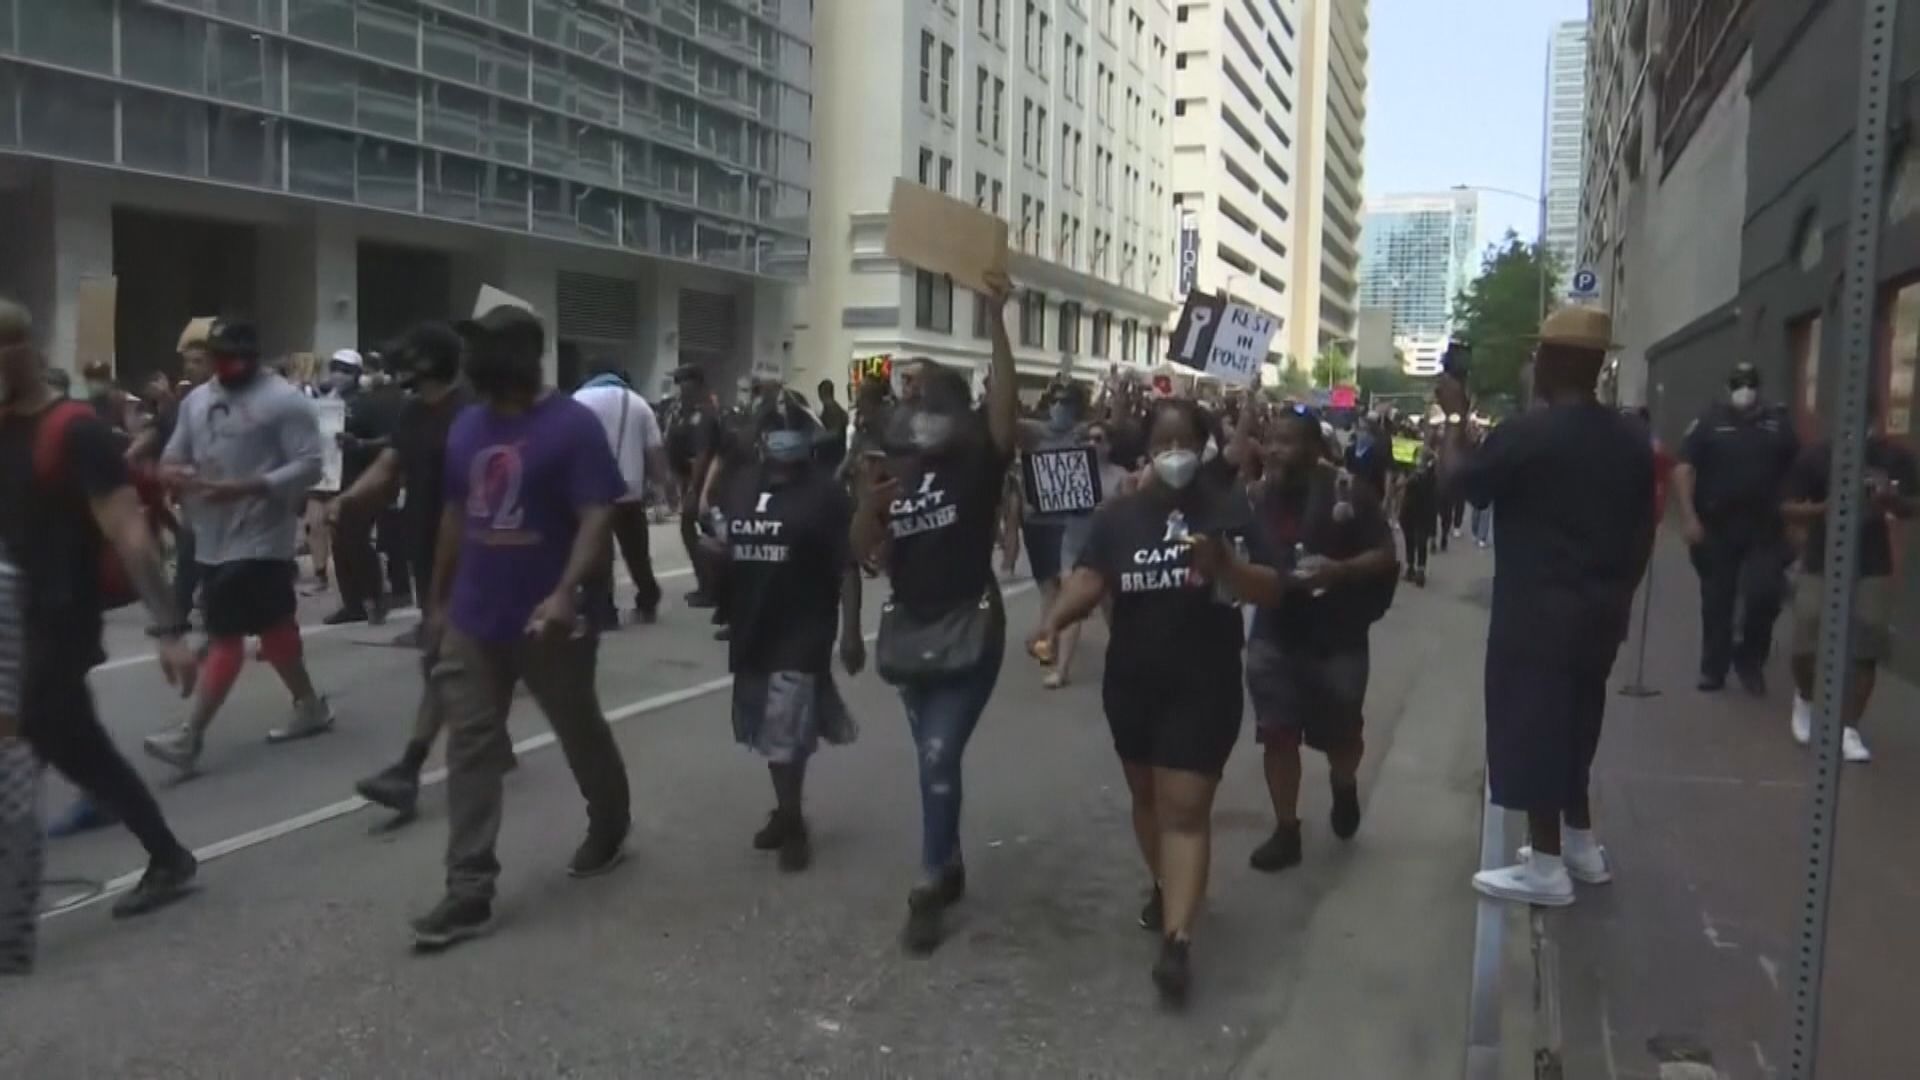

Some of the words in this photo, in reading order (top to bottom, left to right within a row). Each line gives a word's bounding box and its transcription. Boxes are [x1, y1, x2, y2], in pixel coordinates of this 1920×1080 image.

[1236, 335, 1254, 351] IN
[1032, 451, 1088, 475] BLACK
[919, 472, 936, 493] I
[1036, 469, 1090, 495] LIVES
[755, 492, 773, 513] I
[1040, 487, 1094, 513] MATTER
[731, 519, 783, 536] CAN'T
[1121, 567, 1191, 592] BREAT
